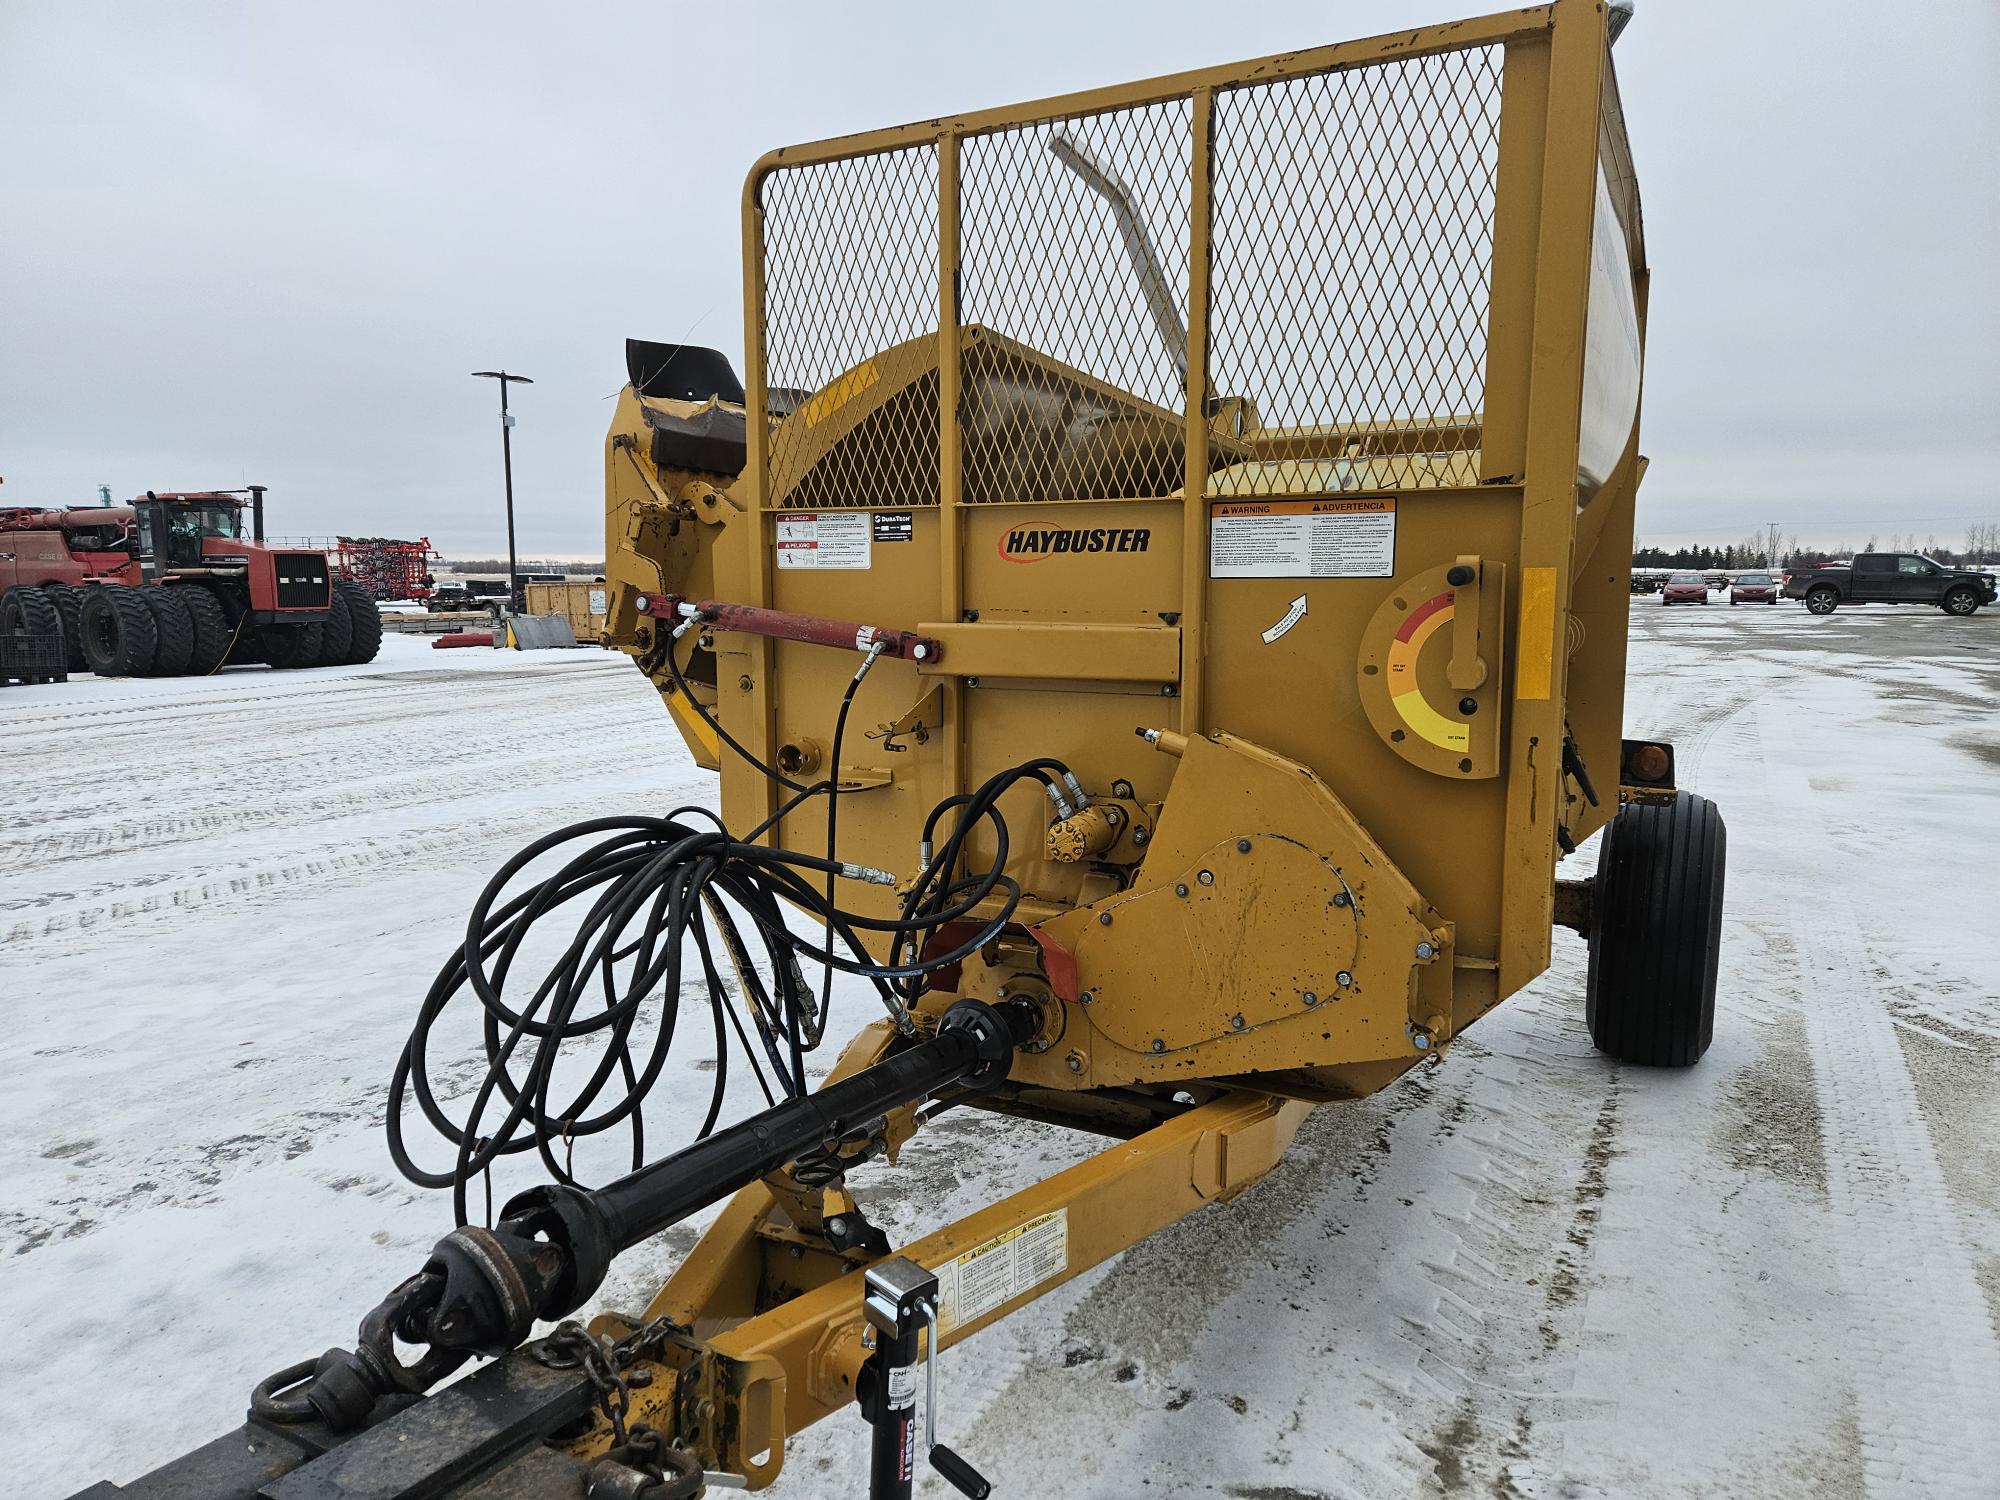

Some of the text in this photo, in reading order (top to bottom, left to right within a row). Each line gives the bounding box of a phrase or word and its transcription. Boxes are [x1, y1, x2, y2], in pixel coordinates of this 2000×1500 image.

[1230, 505, 1270, 514] WARNING
[1321, 502, 1386, 512] ADVERTENCIA
[1006, 528, 1151, 554] HAYBUSTER
[977, 1239, 1002, 1256] CAUTION
[904, 1418, 914, 1465] CASE
